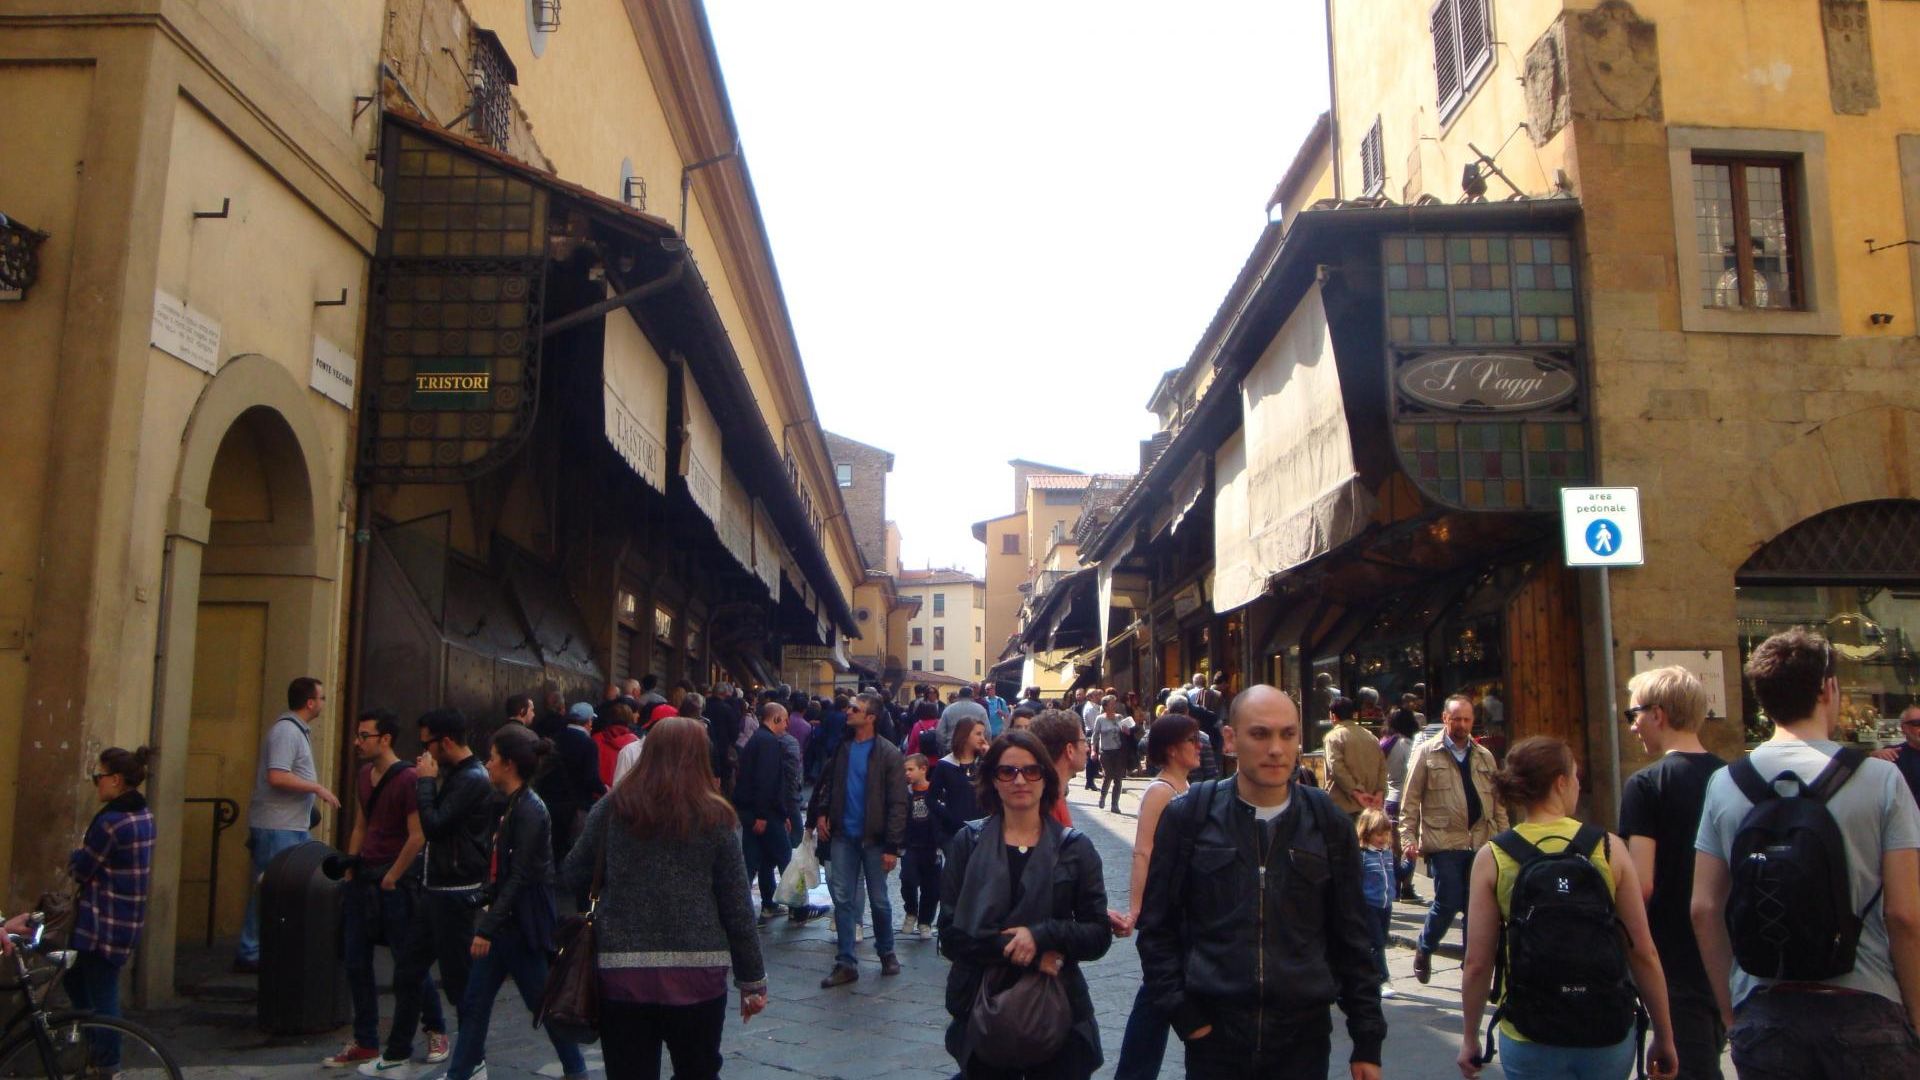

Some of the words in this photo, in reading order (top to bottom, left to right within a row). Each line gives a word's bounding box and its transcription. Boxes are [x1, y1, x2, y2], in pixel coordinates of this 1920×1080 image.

[415, 376, 489, 389] T.RISTORI
[1470, 361, 1548, 400] Vaggi
[1588, 493, 1612, 501] area
[1576, 504, 1627, 514] pedonale
